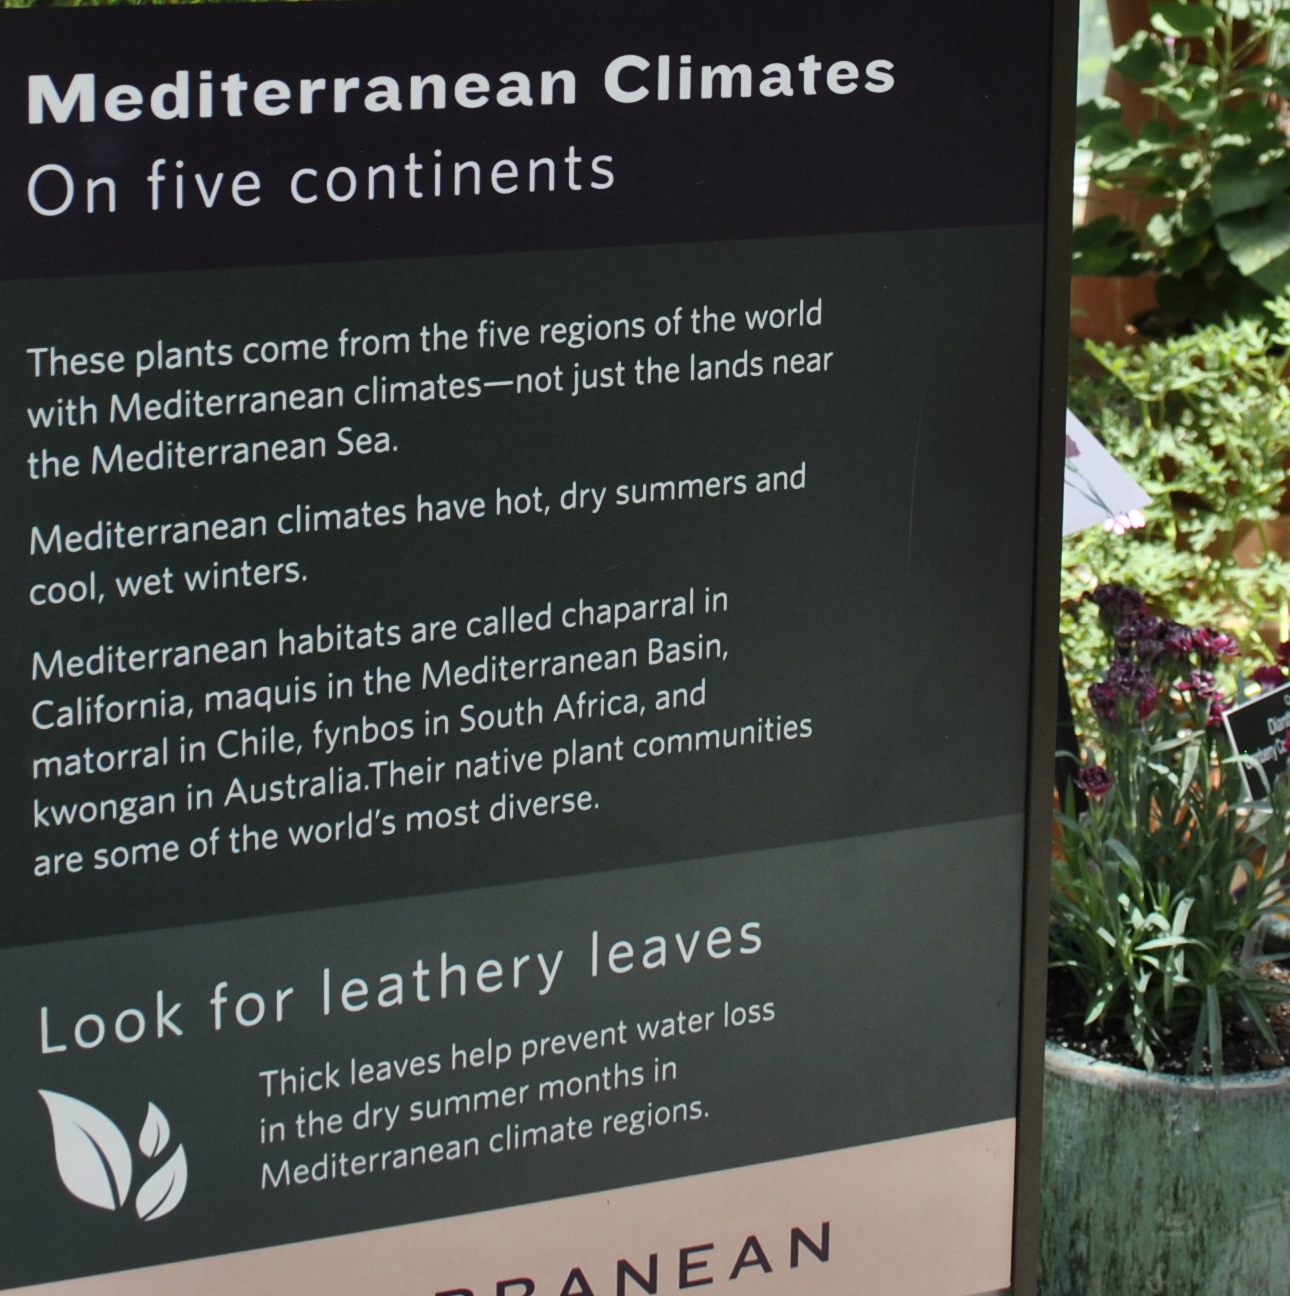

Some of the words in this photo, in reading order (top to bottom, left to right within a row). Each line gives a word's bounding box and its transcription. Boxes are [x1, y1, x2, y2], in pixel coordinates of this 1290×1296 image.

[28, 70, 575, 124] Mediterranean
[605, 55, 894, 103] Climates
[28, 164, 116, 216] On
[147, 159, 261, 210] five
[291, 146, 614, 204] continents
[26, 346, 124, 377] These
[137, 339, 233, 377] plants
[243, 338, 328, 364] come
[338, 328, 409, 357] from
[420, 322, 468, 352] the
[478, 319, 529, 348] five
[540, 314, 645, 348] regions
[655, 307, 682, 336] of
[691, 305, 735, 334] the
[745, 298, 822, 330] world
[27, 396, 97, 428] with
[110, 387, 343, 423] Mediterranean
[572, 361, 625, 396] just
[634, 357, 679, 385] the
[691, 350, 763, 381] lands
[773, 352, 833, 374] near
[27, 449, 79, 479] the
[92, 437, 325, 474] Mediterranean
[338, 427, 397, 455] Sea.
[30, 516, 266, 555] Mediterranean
[278, 501, 406, 534] climates
[417, 494, 485, 522] have
[496, 487, 550, 516] hot,
[560, 481, 606, 513] dry
[616, 475, 747, 505] summers
[756, 461, 805, 493] and
[30, 571, 104, 605] cool,
[116, 567, 173, 597] wet
[184, 560, 307, 591] winters.
[32, 639, 266, 680] Mediterranean
[279, 621, 401, 656] habitats
[411, 620, 456, 643] are
[467, 602, 551, 637] called
[562, 587, 694, 629] chaparral
[705, 587, 727, 613] in
[32, 690, 193, 729] California,
[206, 676, 317, 712] maquis
[329, 672, 352, 699] in
[363, 667, 410, 695] the
[422, 648, 636, 689] Mediterranean
[649, 634, 727, 665] Basin,
[33, 737, 167, 779] matorral
[181, 736, 205, 763] in
[218, 726, 302, 759] Chile,
[313, 716, 414, 754] fynbos
[425, 710, 448, 736] in
[461, 697, 542, 732] South
[554, 690, 645, 721] Africa,
[656, 678, 705, 710] and
[34, 793, 175, 828] kwongan
[187, 784, 212, 810] in
[456, 748, 542, 779] native
[553, 736, 623, 774] plant
[634, 715, 812, 758] communities
[34, 852, 83, 876] are
[94, 841, 179, 869] some
[190, 827, 219, 858] of
[229, 824, 278, 853] the
[288, 809, 395, 846] world's
[407, 799, 479, 832] most
[490, 791, 599, 821] diverse.
[41, 990, 183, 1054] Look
[210, 981, 293, 1030] for
[324, 950, 563, 1015] leathery
[592, 922, 761, 976] leaves
[259, 1062, 340, 1097] Thick
[351, 1054, 441, 1085] leaves
[452, 1038, 511, 1070] help
[522, 1020, 627, 1065] prevent
[637, 1011, 714, 1040] water
[725, 1002, 775, 1027] loss
[261, 1118, 285, 1144] in
[296, 1110, 342, 1138] the
[353, 1102, 399, 1131] dry
[410, 1085, 529, 1121] summer
[539, 1063, 644, 1100] months
[655, 1057, 676, 1082] in
[262, 1137, 478, 1189] Mediterranean
[490, 1116, 592, 1152] climate
[604, 1101, 708, 1135] regions.
[434, 1221, 830, 1296] ANEAN
